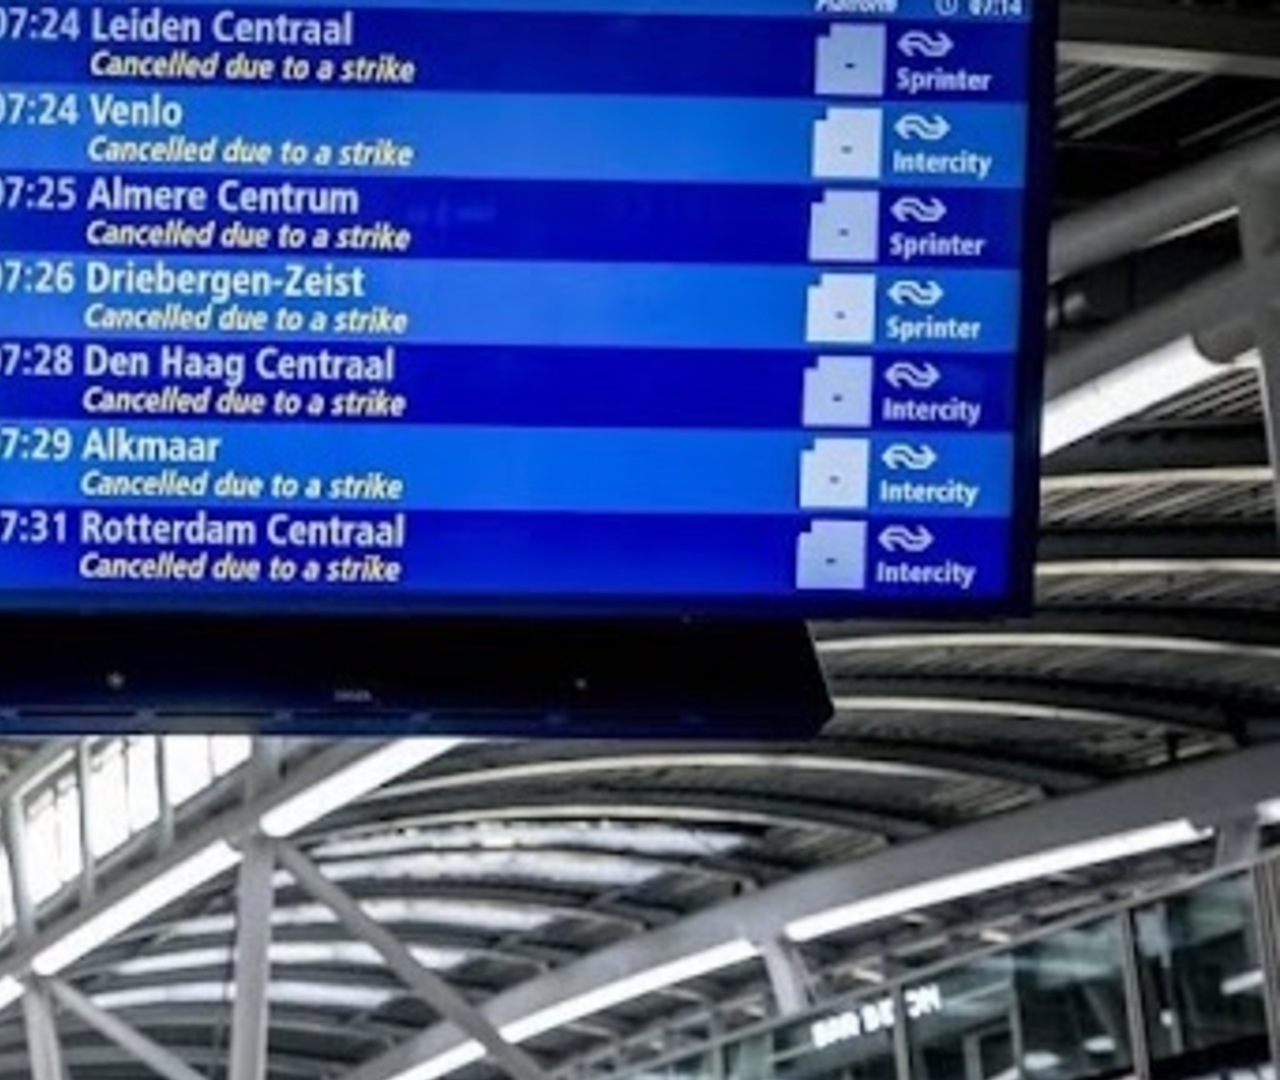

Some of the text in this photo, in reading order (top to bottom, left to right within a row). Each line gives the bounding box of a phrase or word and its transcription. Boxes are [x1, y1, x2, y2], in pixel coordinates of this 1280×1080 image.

[92, 8, 200, 41] Leiden
[212, 10, 351, 45] Centraal
[897, 68, 991, 93] Sprinter
[90, 93, 182, 127] Venlo
[88, 135, 413, 166] Cancelled due to a strike
[894, 151, 991, 178] Intercity
[88, 177, 207, 210] Almere
[218, 180, 358, 213] Centrum
[890, 233, 985, 259] Sprinter
[86, 261, 364, 302] Driebergen-Zeist
[887, 316, 980, 342] Sprinter
[85, 345, 148, 376] Den
[161, 346, 244, 386] Haag
[256, 347, 393, 380] Centraal
[883, 398, 980, 426] Intercity
[82, 428, 221, 461] Alkmaar
[880, 480, 978, 507] Intercity
[82, 511, 256, 544] Rotterdam
[267, 514, 404, 546] Centraal
[80, 552, 401, 581] Cancelled due to a strike
[877, 561, 975, 589] Intercity
